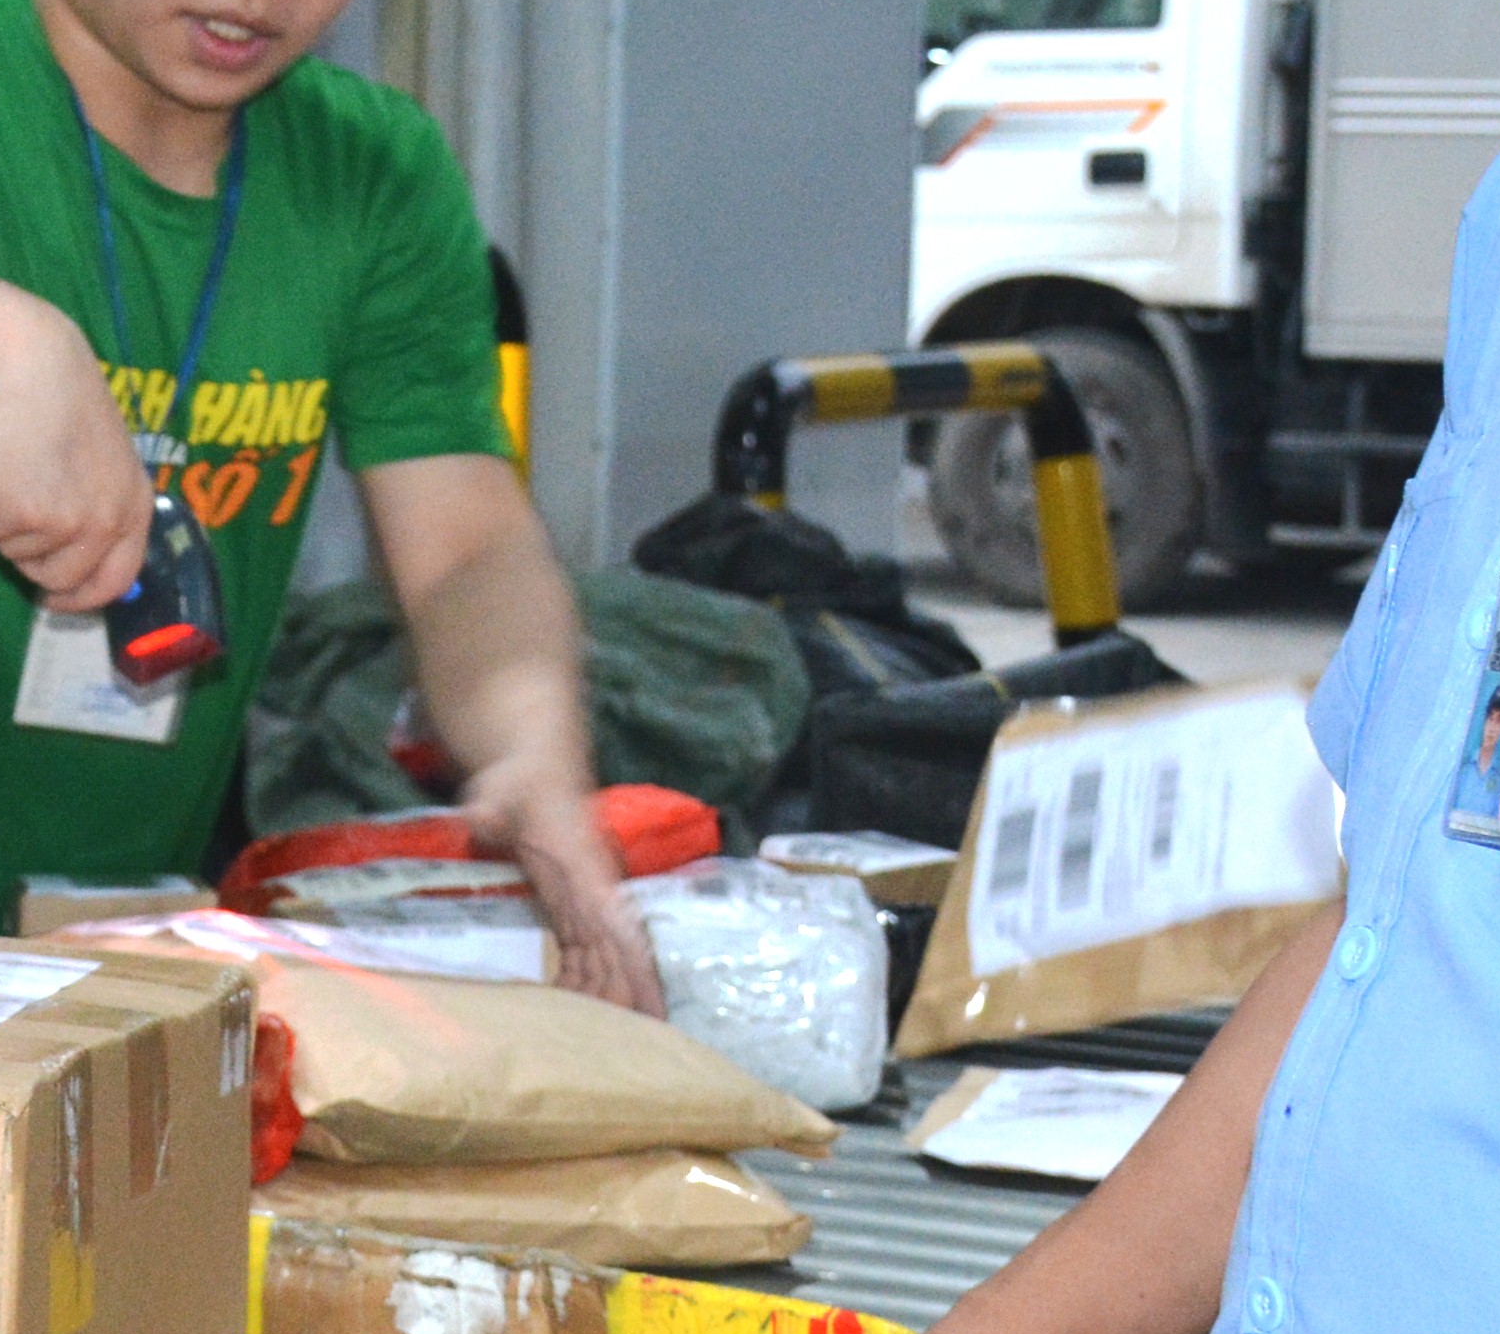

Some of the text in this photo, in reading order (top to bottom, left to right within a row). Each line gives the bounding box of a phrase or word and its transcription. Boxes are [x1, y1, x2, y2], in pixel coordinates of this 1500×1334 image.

[187, 367, 329, 447] HÀNG
[180, 442, 320, 530] SỐ 1
